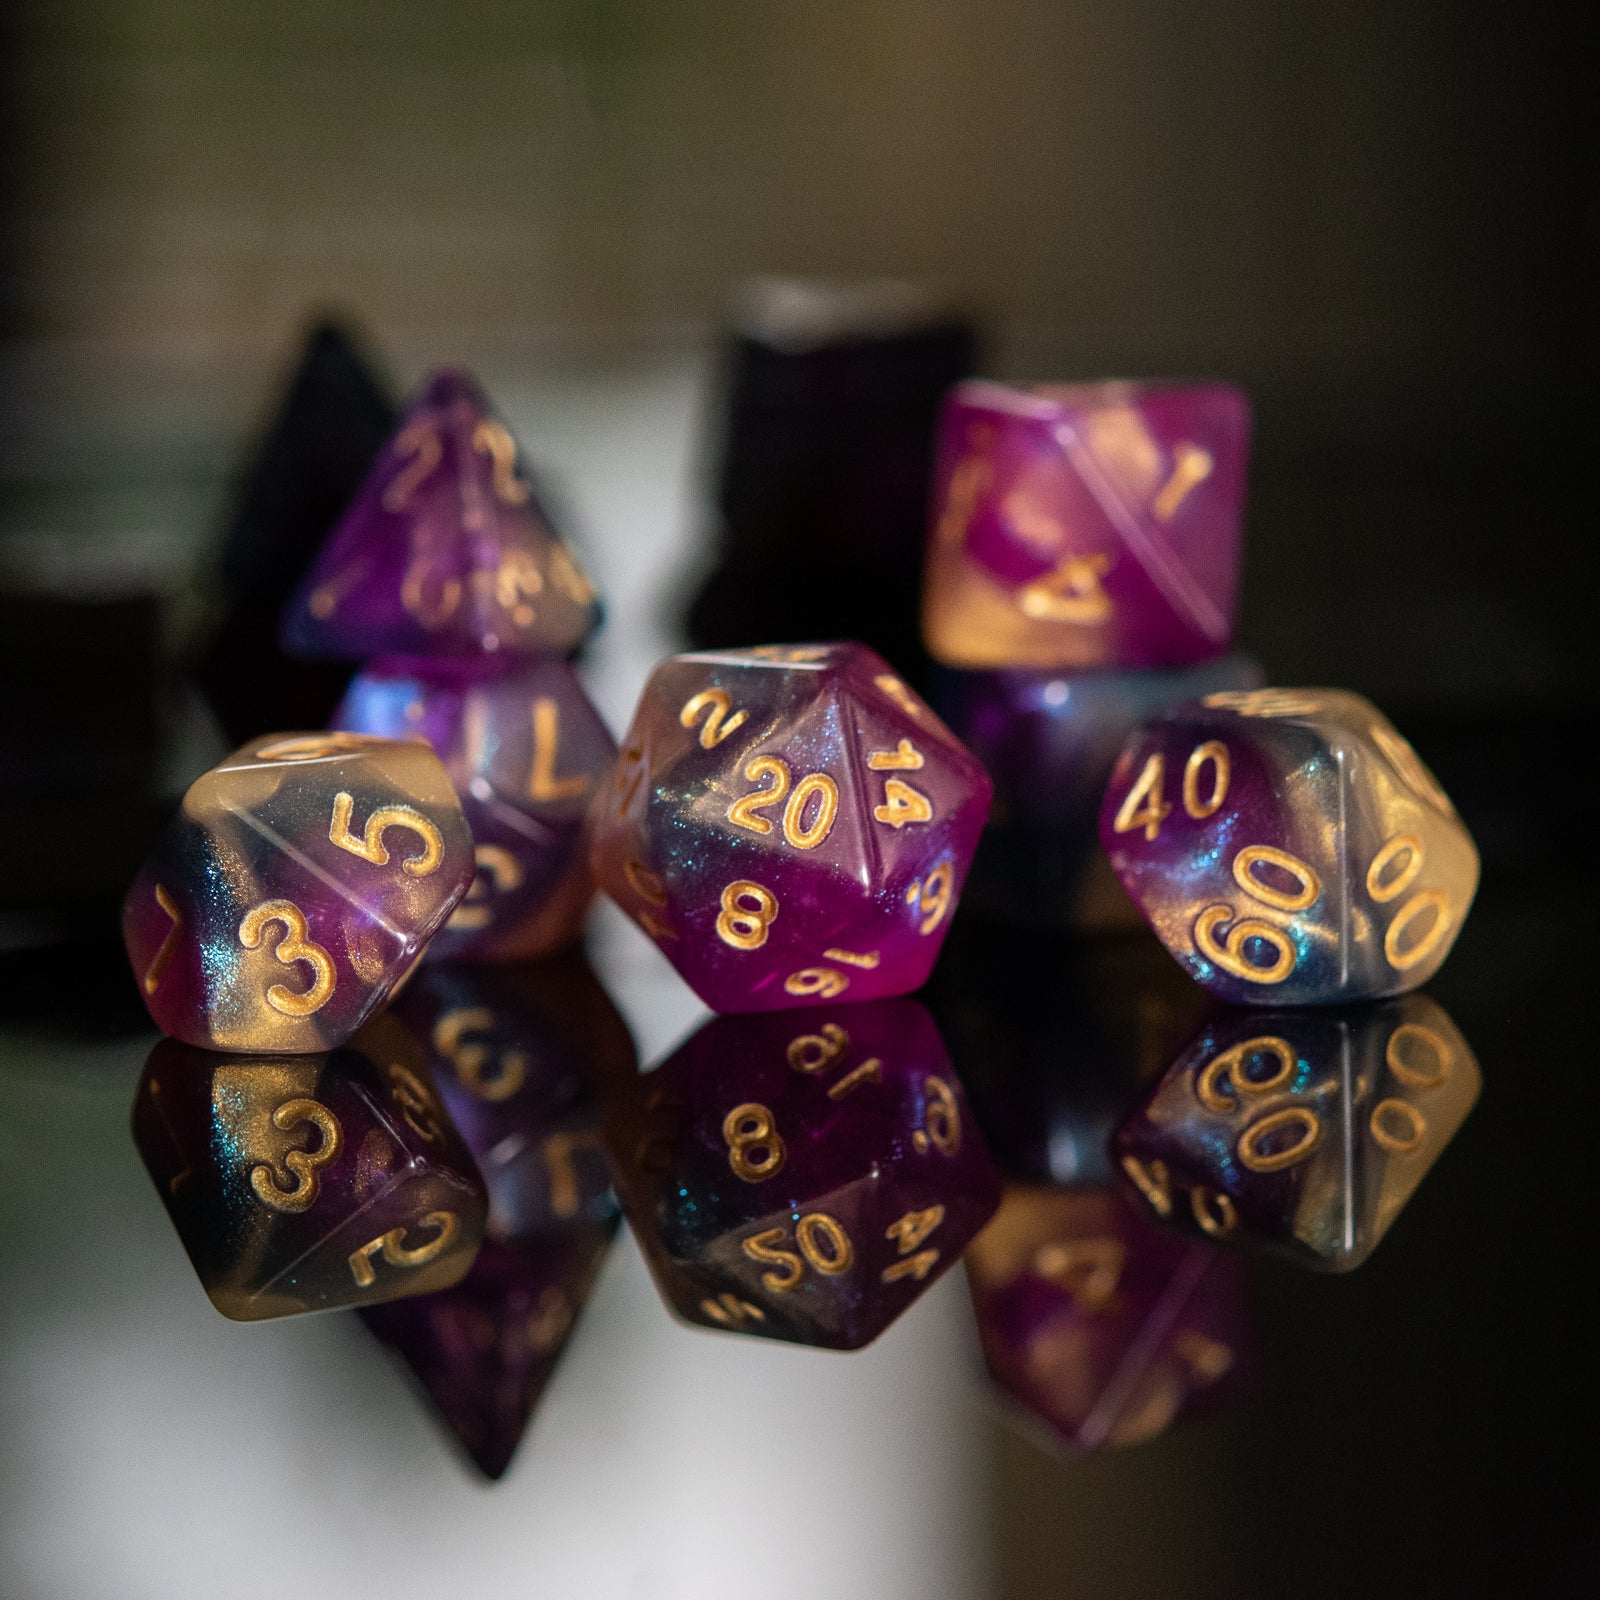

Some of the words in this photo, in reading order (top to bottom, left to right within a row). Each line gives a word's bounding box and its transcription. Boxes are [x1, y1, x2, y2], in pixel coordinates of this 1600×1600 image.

[680, 687, 750, 750] 2
[726, 755, 839, 850] 20
[867, 738, 933, 829] 14
[1113, 740, 1232, 842] 40
[329, 790, 446, 878] 5
[238, 898, 337, 1017] 3
[716, 879, 780, 951] 8
[1193, 844, 1322, 985] 60
